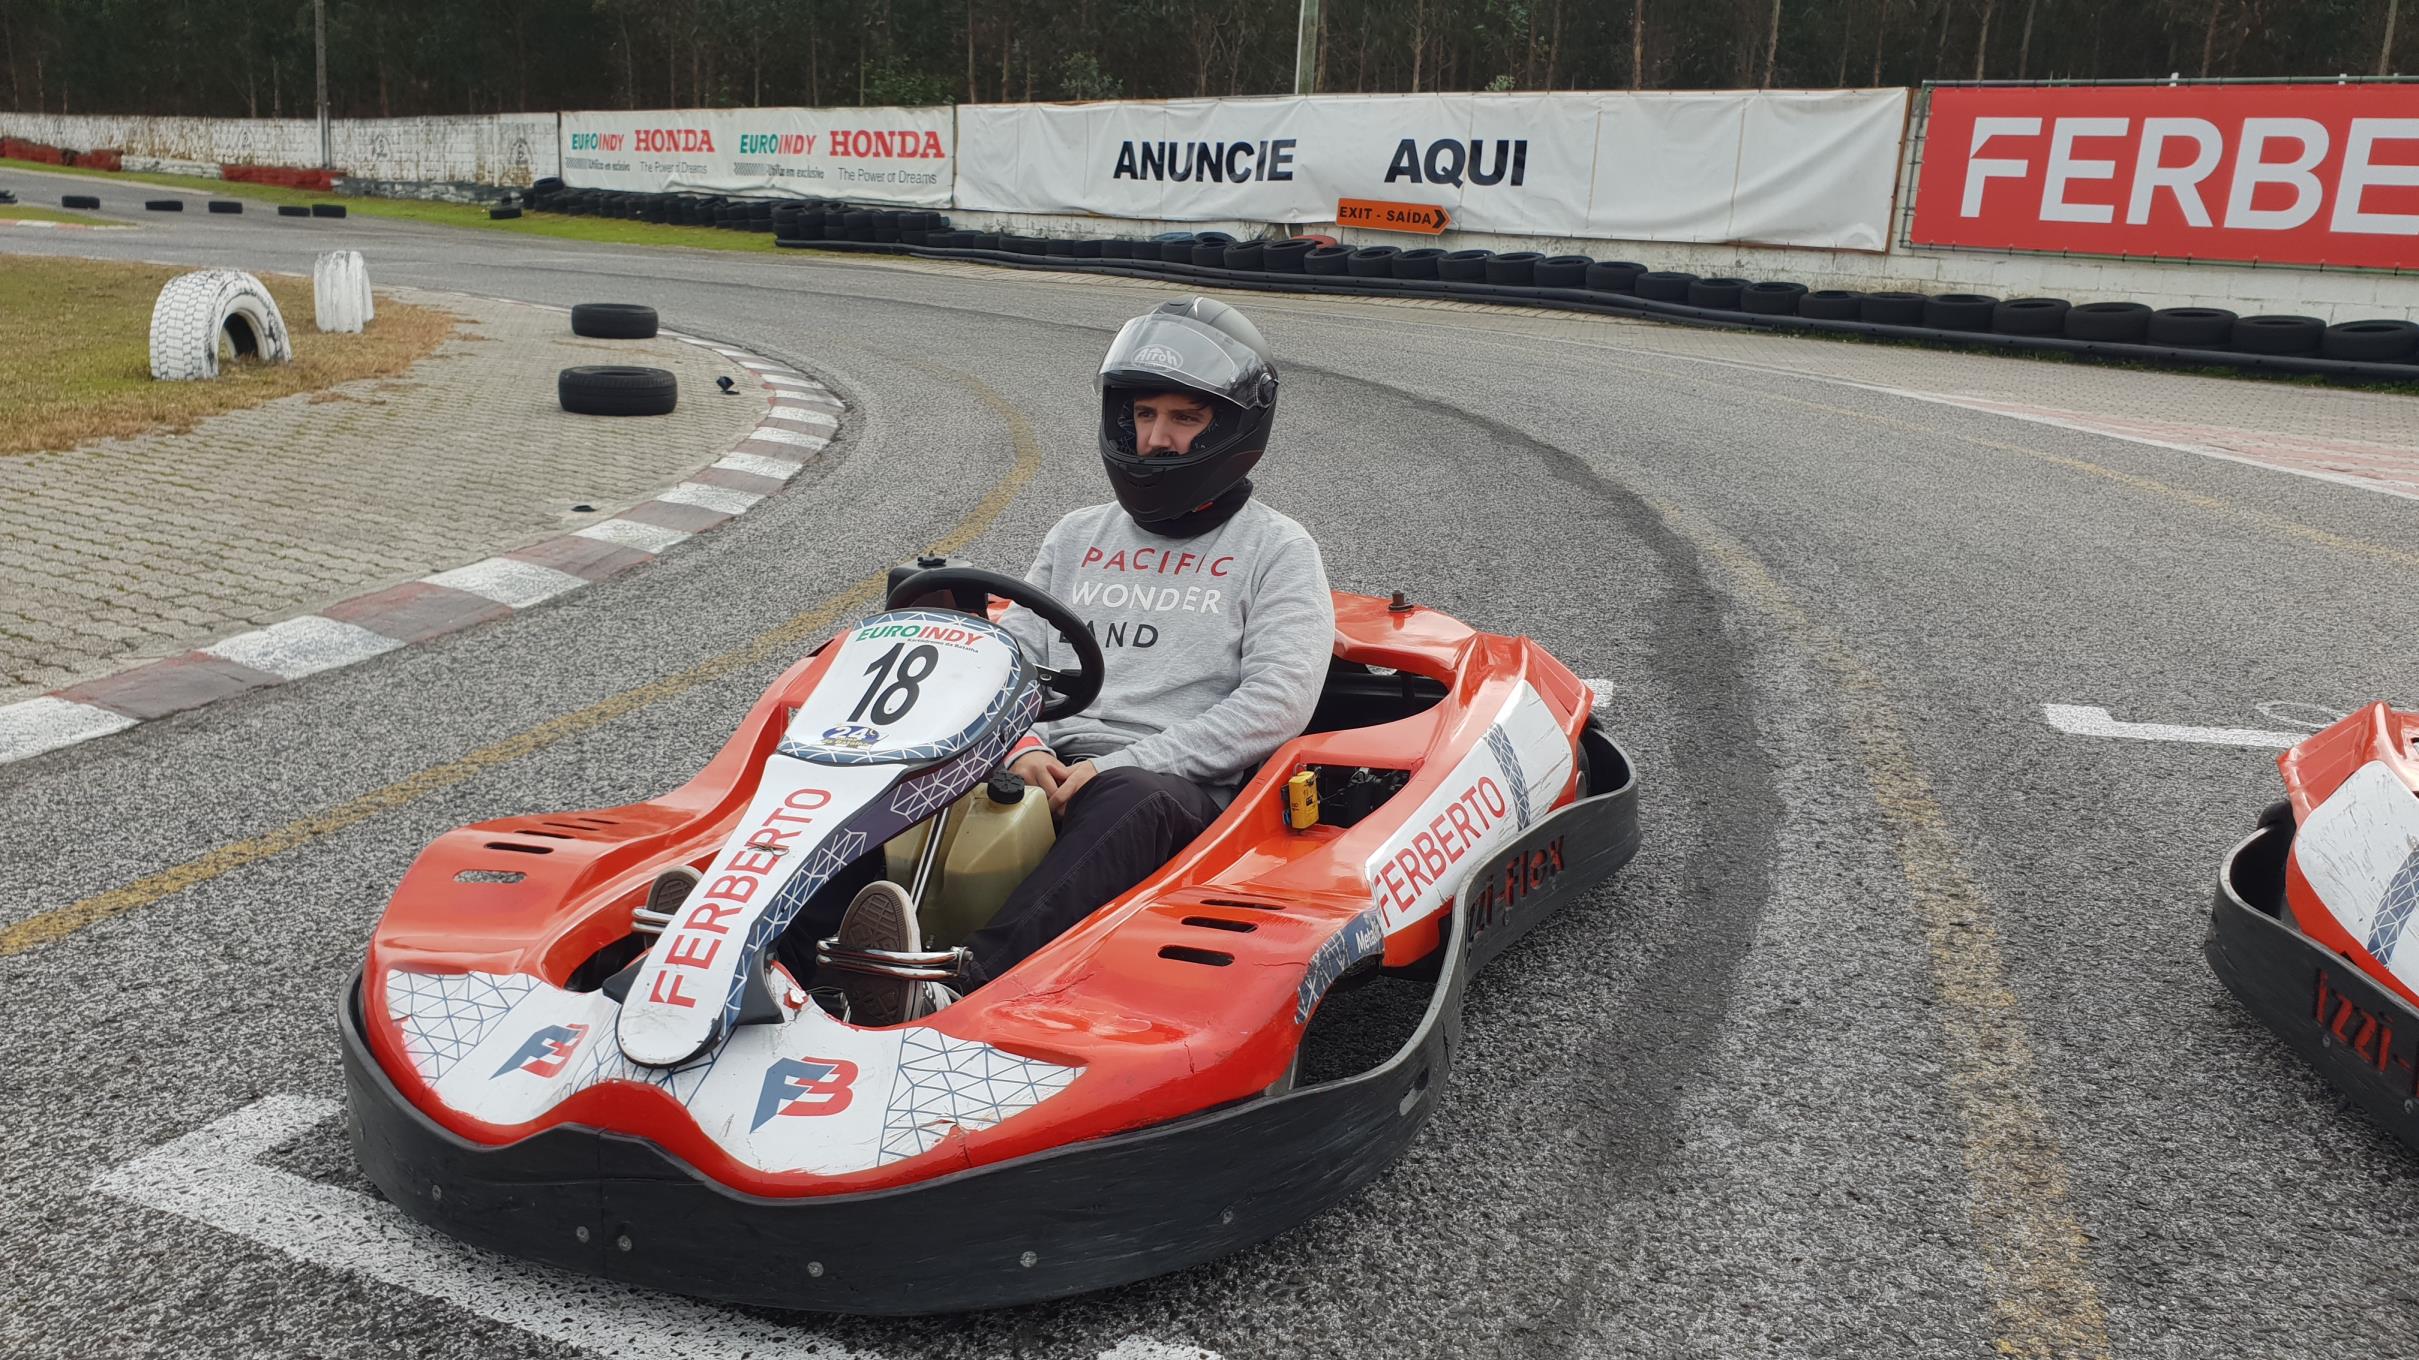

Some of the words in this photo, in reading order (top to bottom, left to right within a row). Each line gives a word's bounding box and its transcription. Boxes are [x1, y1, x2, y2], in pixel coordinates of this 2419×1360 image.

[571, 133, 624, 151] EUROINDY
[634, 129, 715, 153] HONDA
[740, 134, 816, 155] EUROINDY
[829, 130, 945, 158] HONDA
[838, 167, 855, 181] The
[858, 169, 885, 182] Power
[898, 170, 937, 185] Dreams
[1113, 139, 1296, 182] ANUNCIE
[1384, 139, 1528, 188] AQUI
[1960, 117, 2419, 235] FERBE
[1340, 206, 1372, 219] EXIT
[1386, 209, 1431, 224] SAÍDA
[1081, 546, 1234, 576] PACIFIC
[1072, 581, 1221, 614] WONDER
[856, 625, 984, 646] EUROINDY
[847, 643, 939, 725] 18
[1374, 776, 1506, 928] FERBERTO
[649, 788, 832, 1008] FERBERTO
